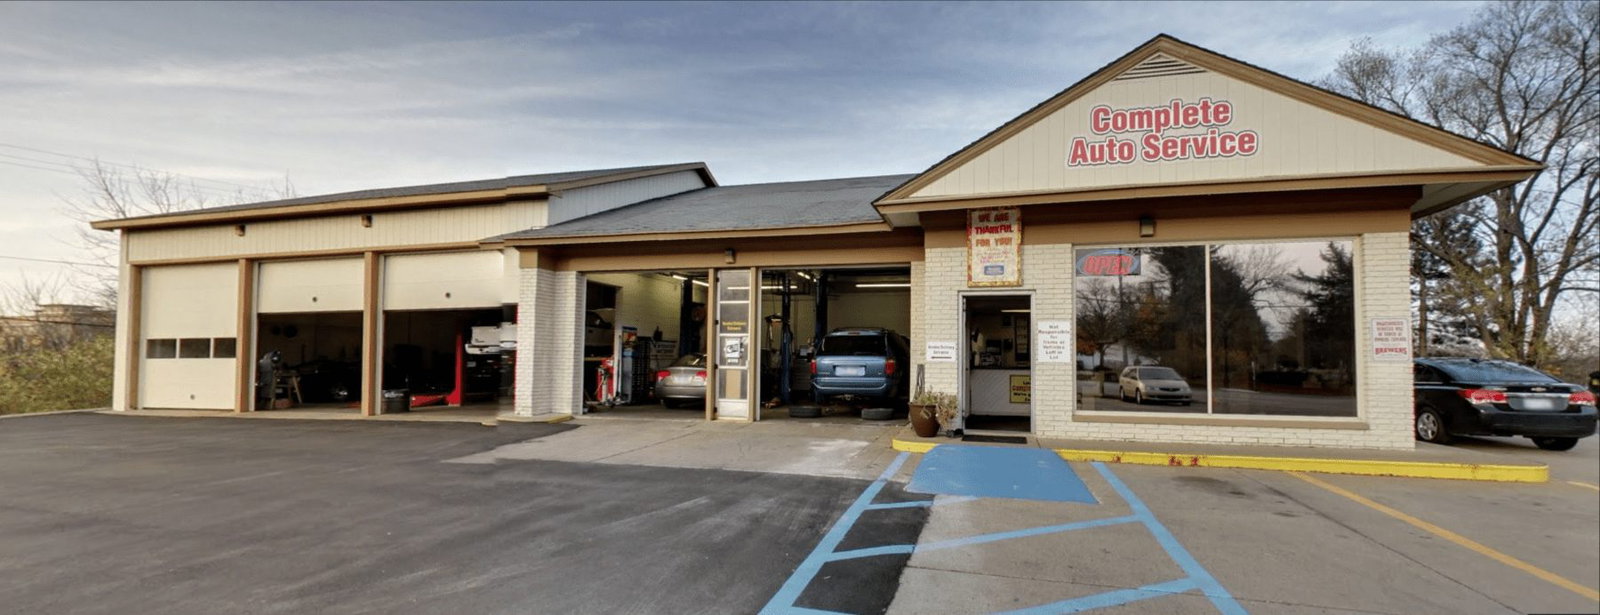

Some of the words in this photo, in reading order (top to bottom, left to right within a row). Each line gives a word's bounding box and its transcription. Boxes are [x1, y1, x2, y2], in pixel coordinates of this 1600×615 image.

[1091, 98, 1232, 134] Complete
[1068, 137, 1136, 167] Auto
[1141, 129, 1257, 161] Service
[978, 212, 991, 223] WE
[994, 212, 1010, 223] ARE
[974, 225, 1014, 235] THANKFUL
[976, 238, 991, 247] FOR
[1083, 255, 1133, 276] OPEN
